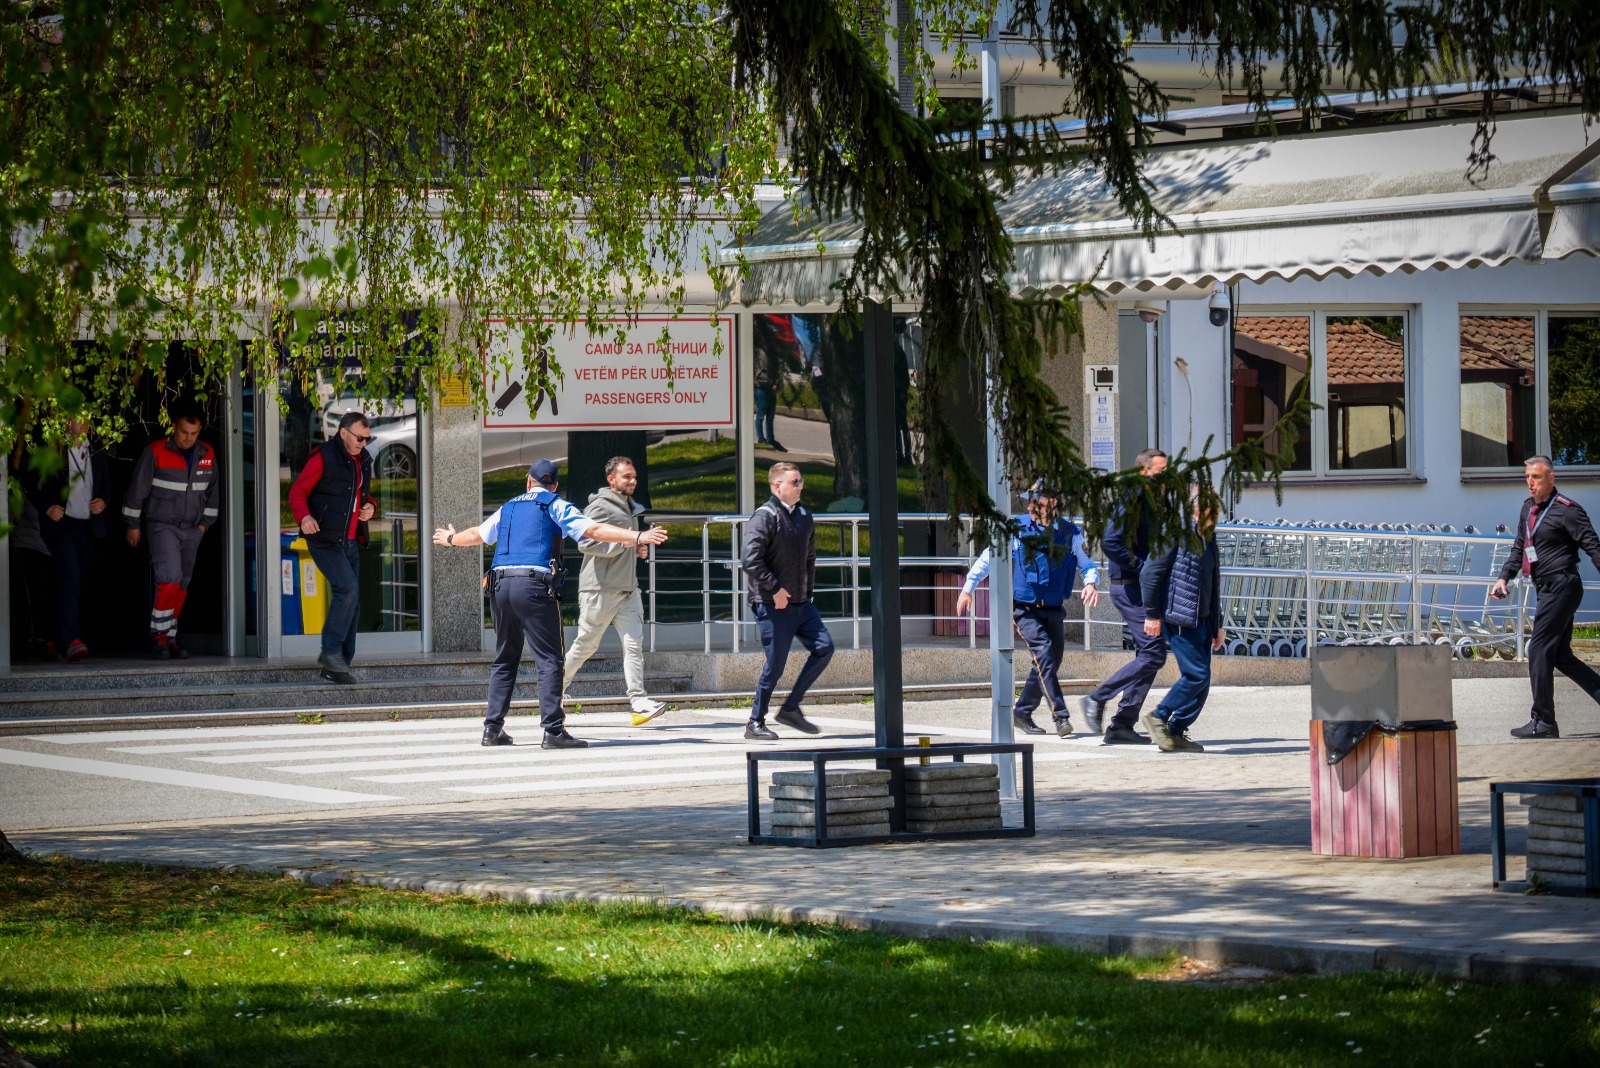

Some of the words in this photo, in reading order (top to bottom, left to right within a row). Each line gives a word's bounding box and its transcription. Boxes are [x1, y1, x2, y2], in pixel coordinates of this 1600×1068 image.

[585, 342, 623, 355] САМО
[626, 342, 644, 355] ЗА
[647, 342, 708, 356] ПАТНИЦИ
[574, 366, 618, 380] VETËM
[621, 365, 647, 380] PËR
[651, 364, 719, 380] UDHËTARË
[585, 392, 671, 405] PASSENGERS
[674, 391, 708, 404] ONLY
